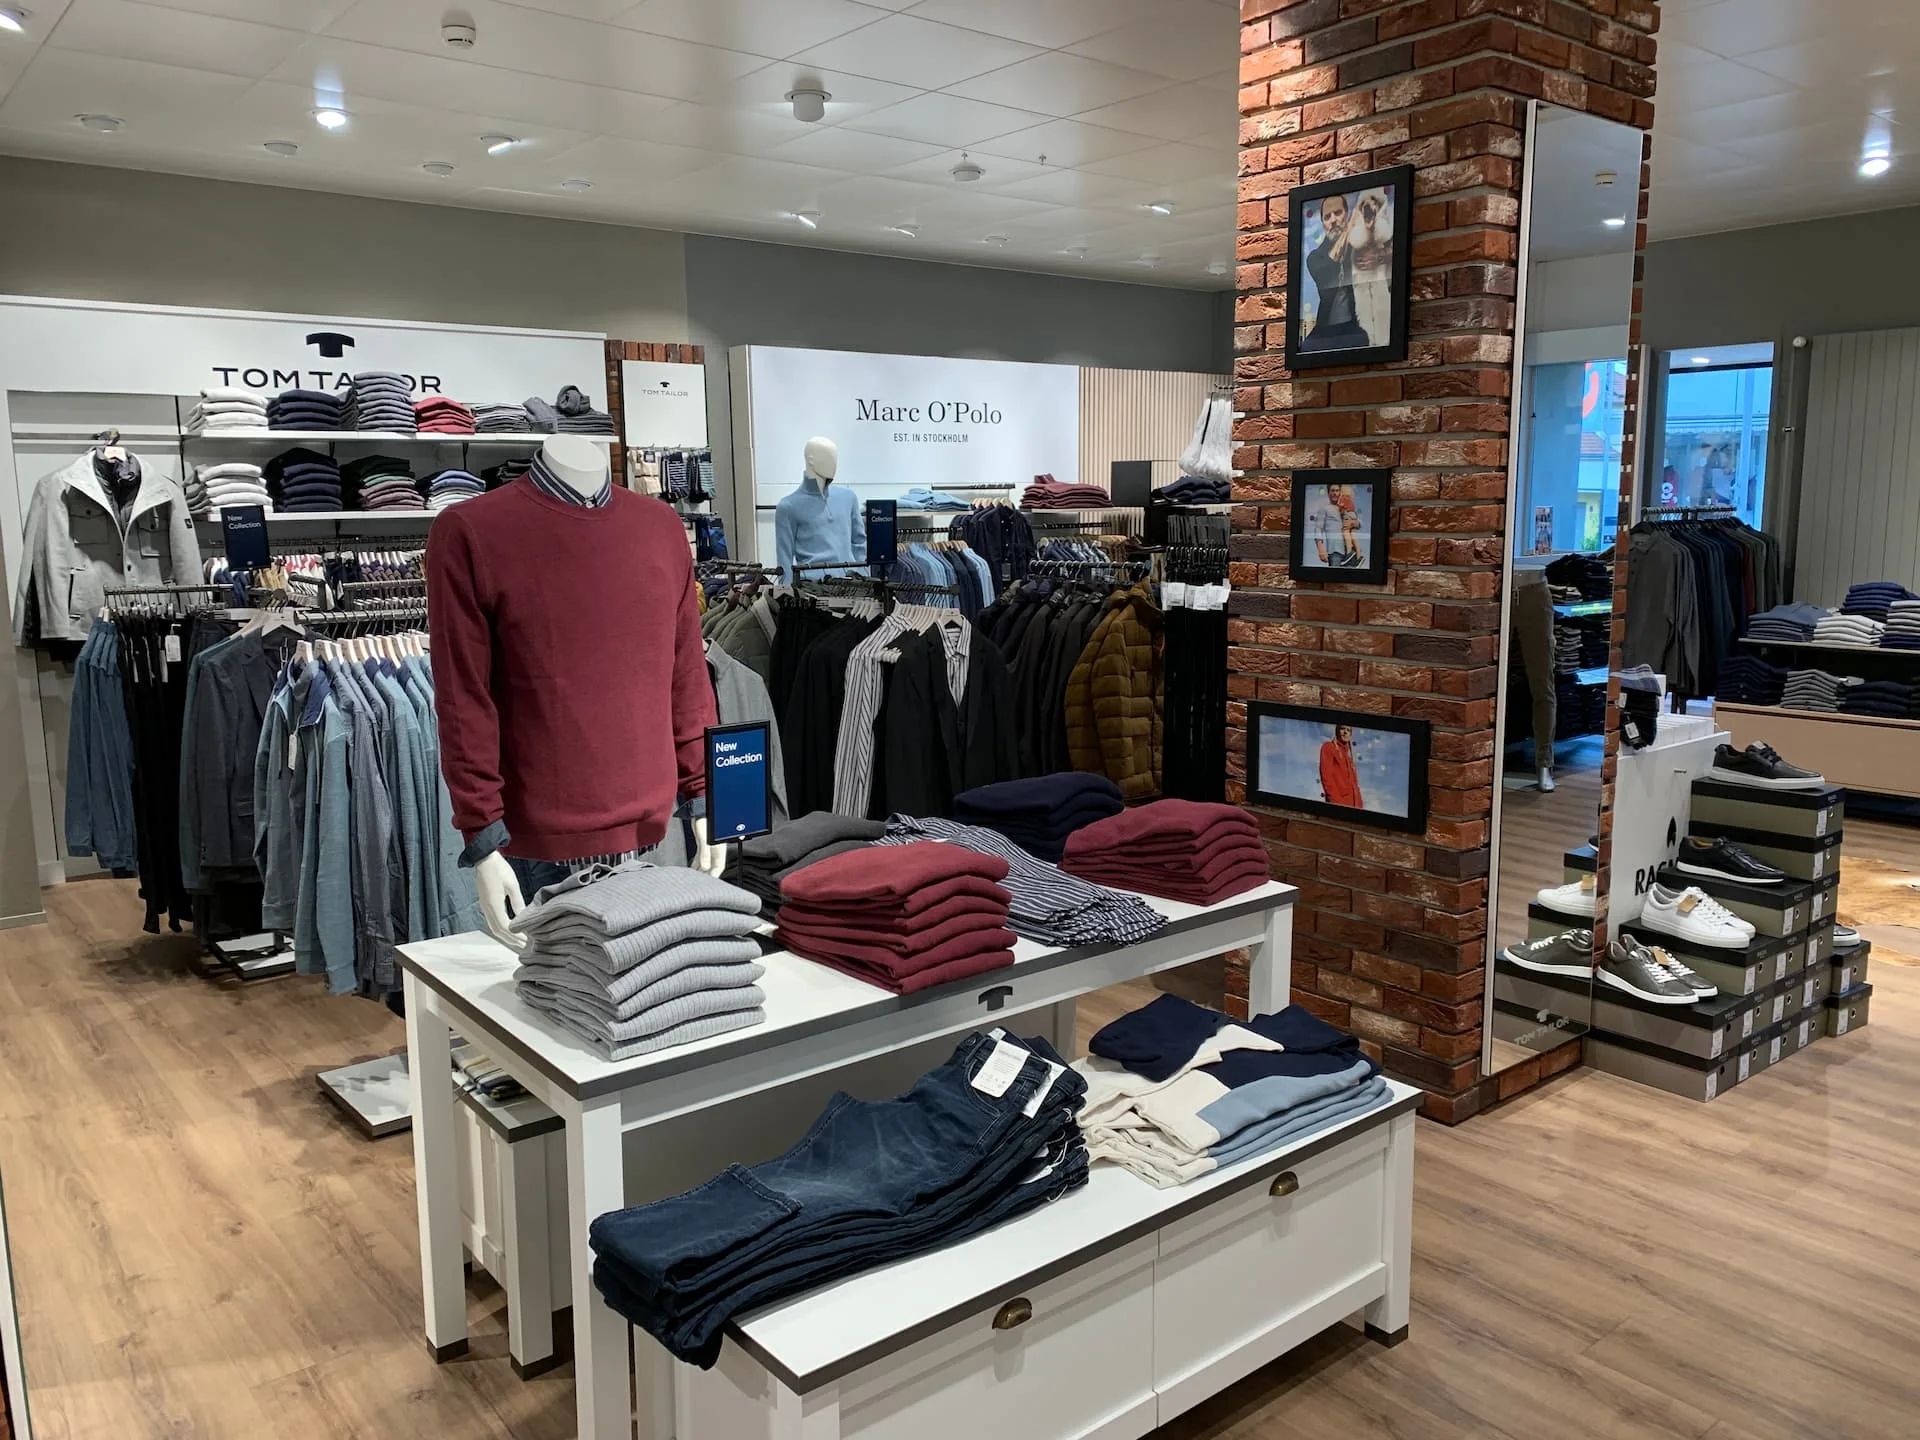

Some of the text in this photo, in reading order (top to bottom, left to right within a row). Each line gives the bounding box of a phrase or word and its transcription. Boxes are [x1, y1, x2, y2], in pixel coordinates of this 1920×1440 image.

[212, 367, 442, 393] TOM TAOR
[855, 398, 1002, 424] Marc O'Polo
[893, 433, 969, 443] EST. IN STOCKHOLM
[228, 522, 262, 530] Collection
[715, 742, 738, 753] New
[715, 753, 763, 768] Collection
